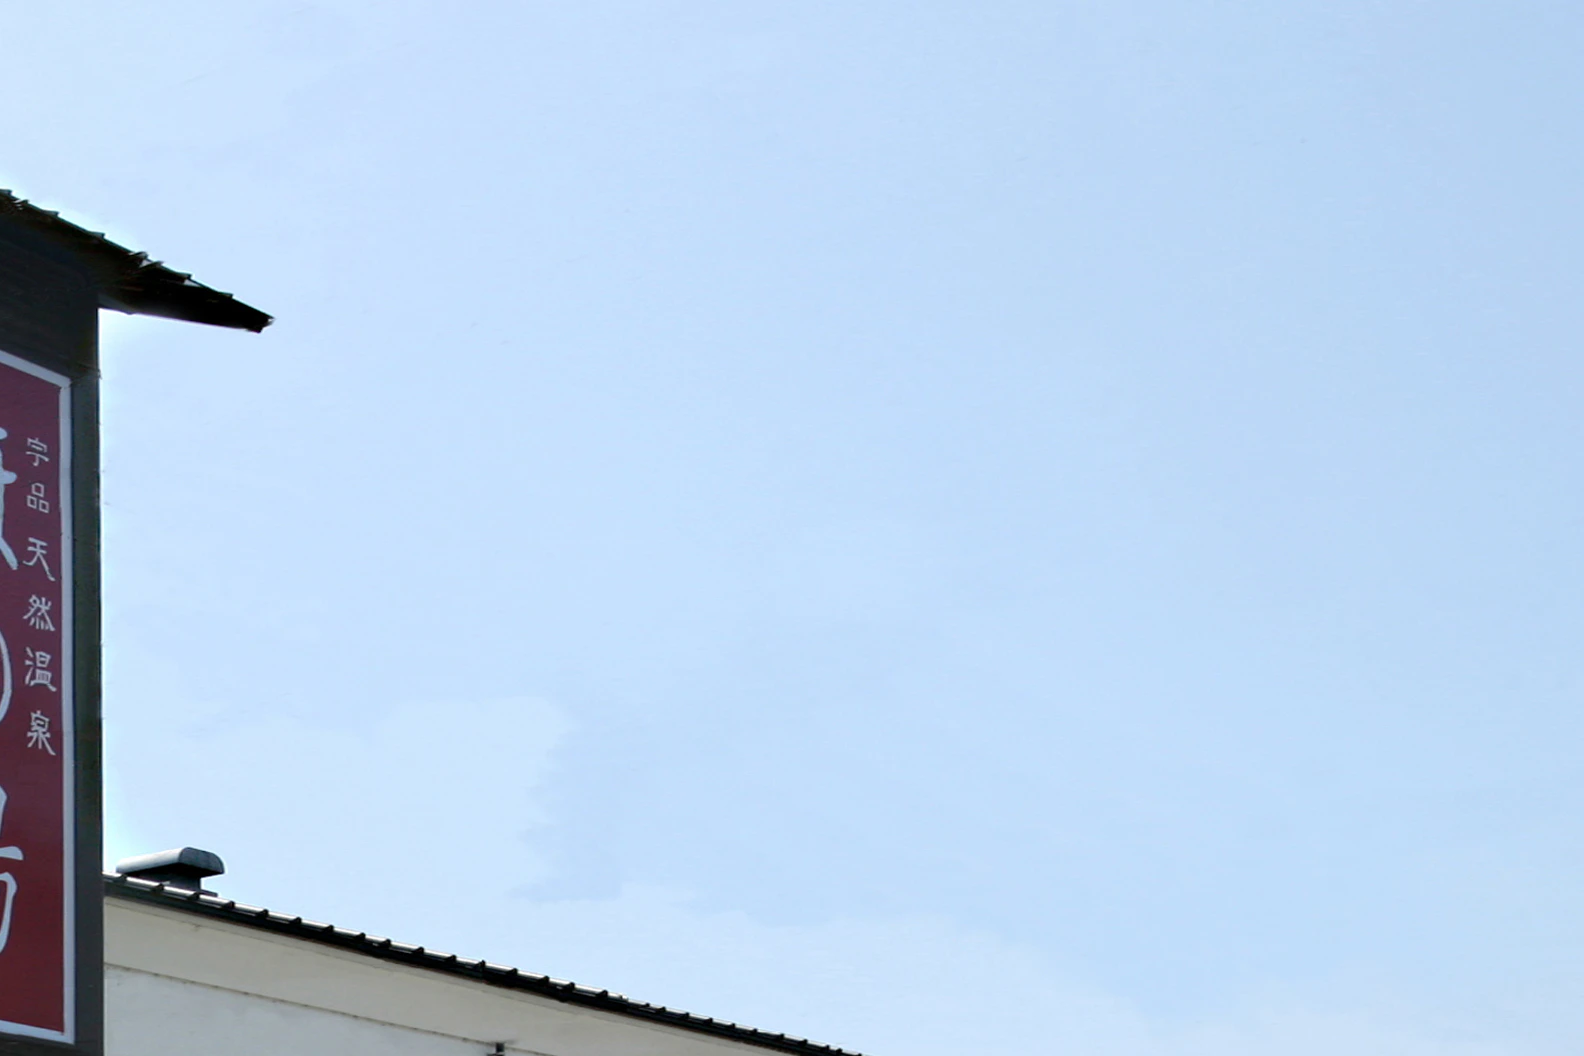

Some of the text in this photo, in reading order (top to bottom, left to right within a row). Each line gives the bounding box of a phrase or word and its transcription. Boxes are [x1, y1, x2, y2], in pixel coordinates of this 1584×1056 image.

[23, 437, 57, 756] 宇品天然温泉
